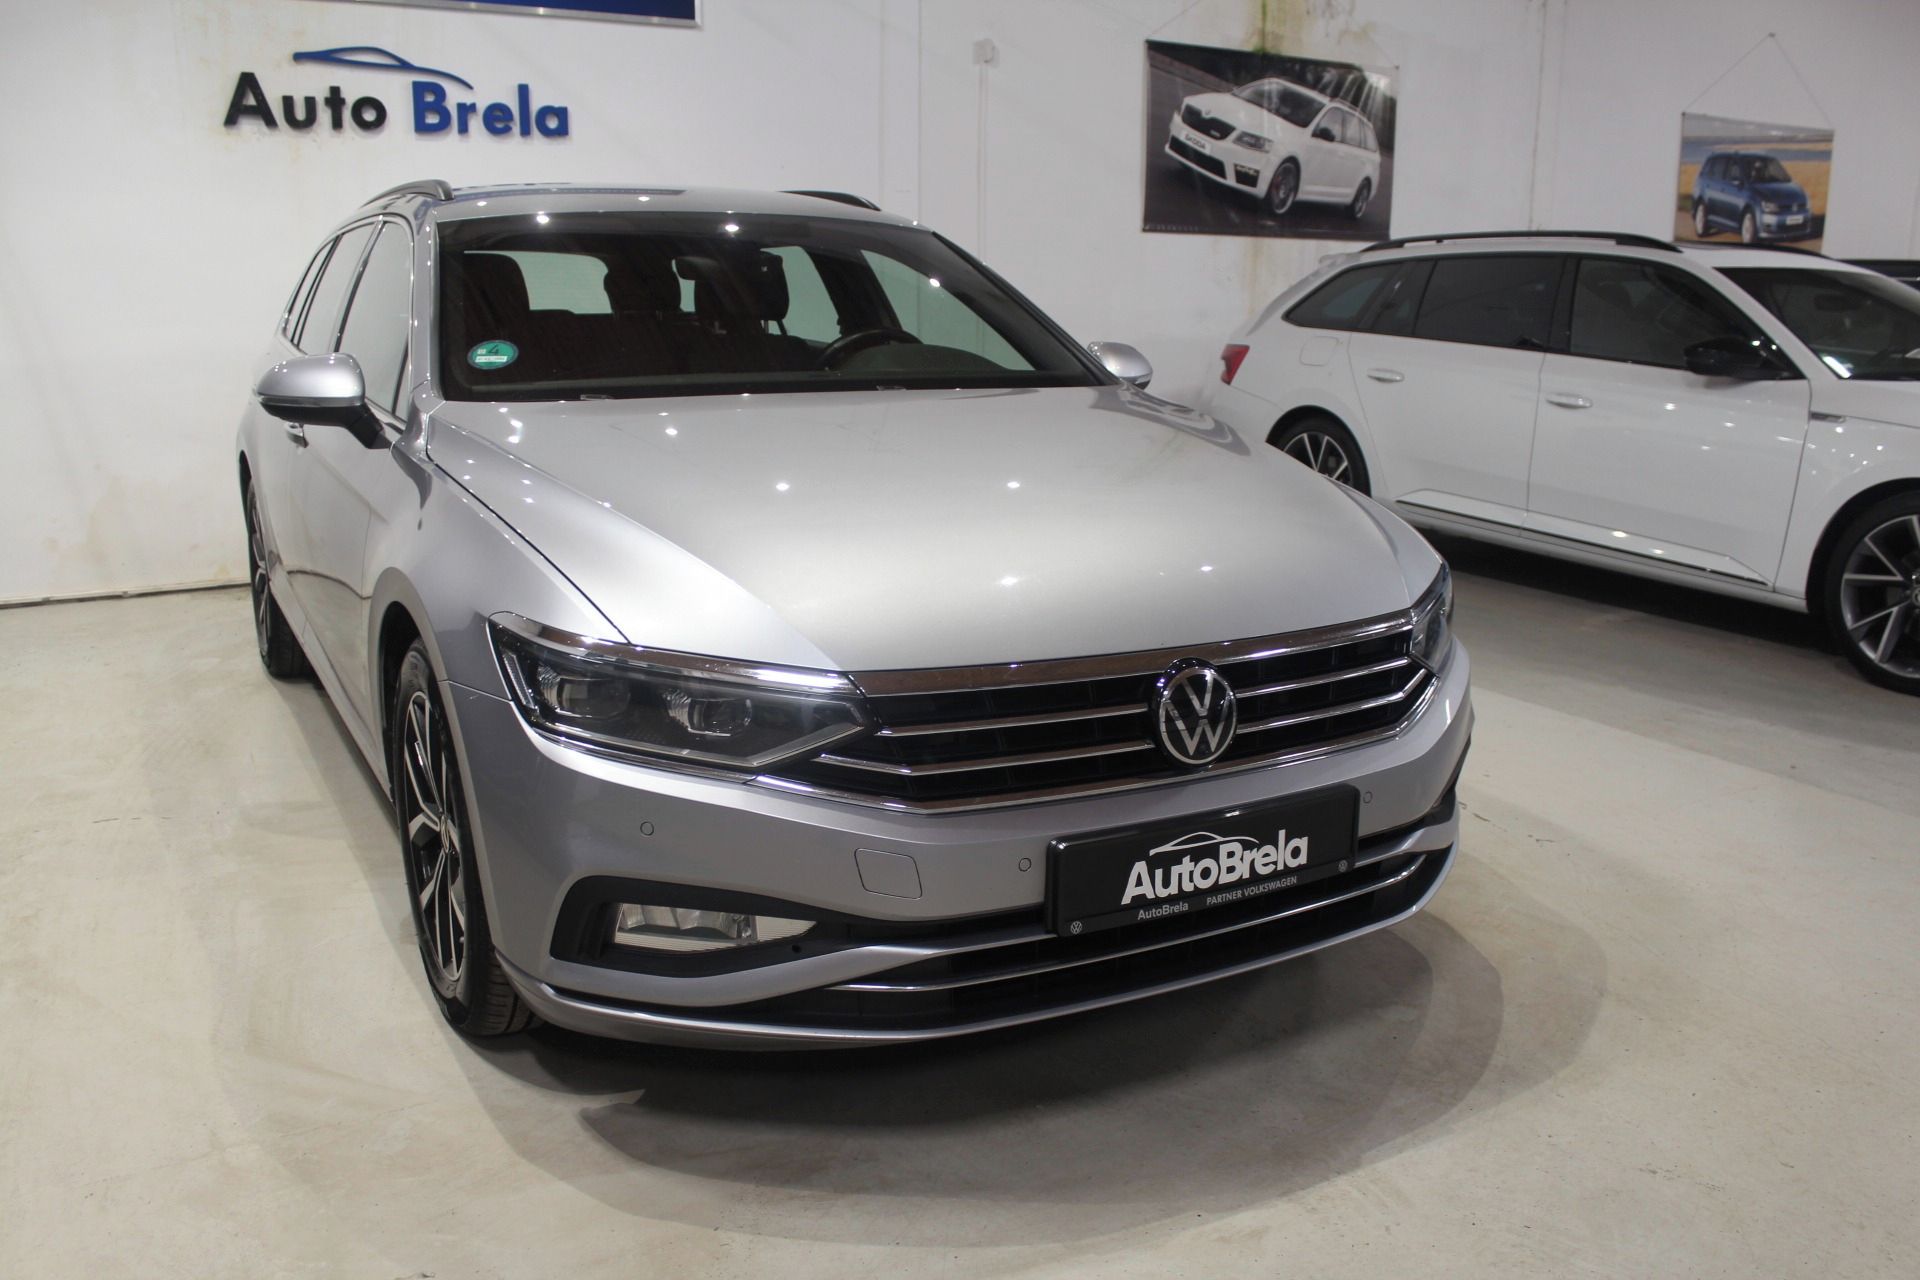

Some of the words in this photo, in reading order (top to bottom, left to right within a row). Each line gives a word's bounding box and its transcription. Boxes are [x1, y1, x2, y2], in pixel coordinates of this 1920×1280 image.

[224, 71, 388, 130] Auto
[411, 79, 570, 137] Brela
[487, 344, 499, 355] 4
[1121, 829, 1308, 904] AutoBrela
[1206, 889, 1242, 906] PARTNER
[1244, 875, 1298, 896] VOLKSWAGEN
[1138, 901, 1189, 921] AutoBrela
